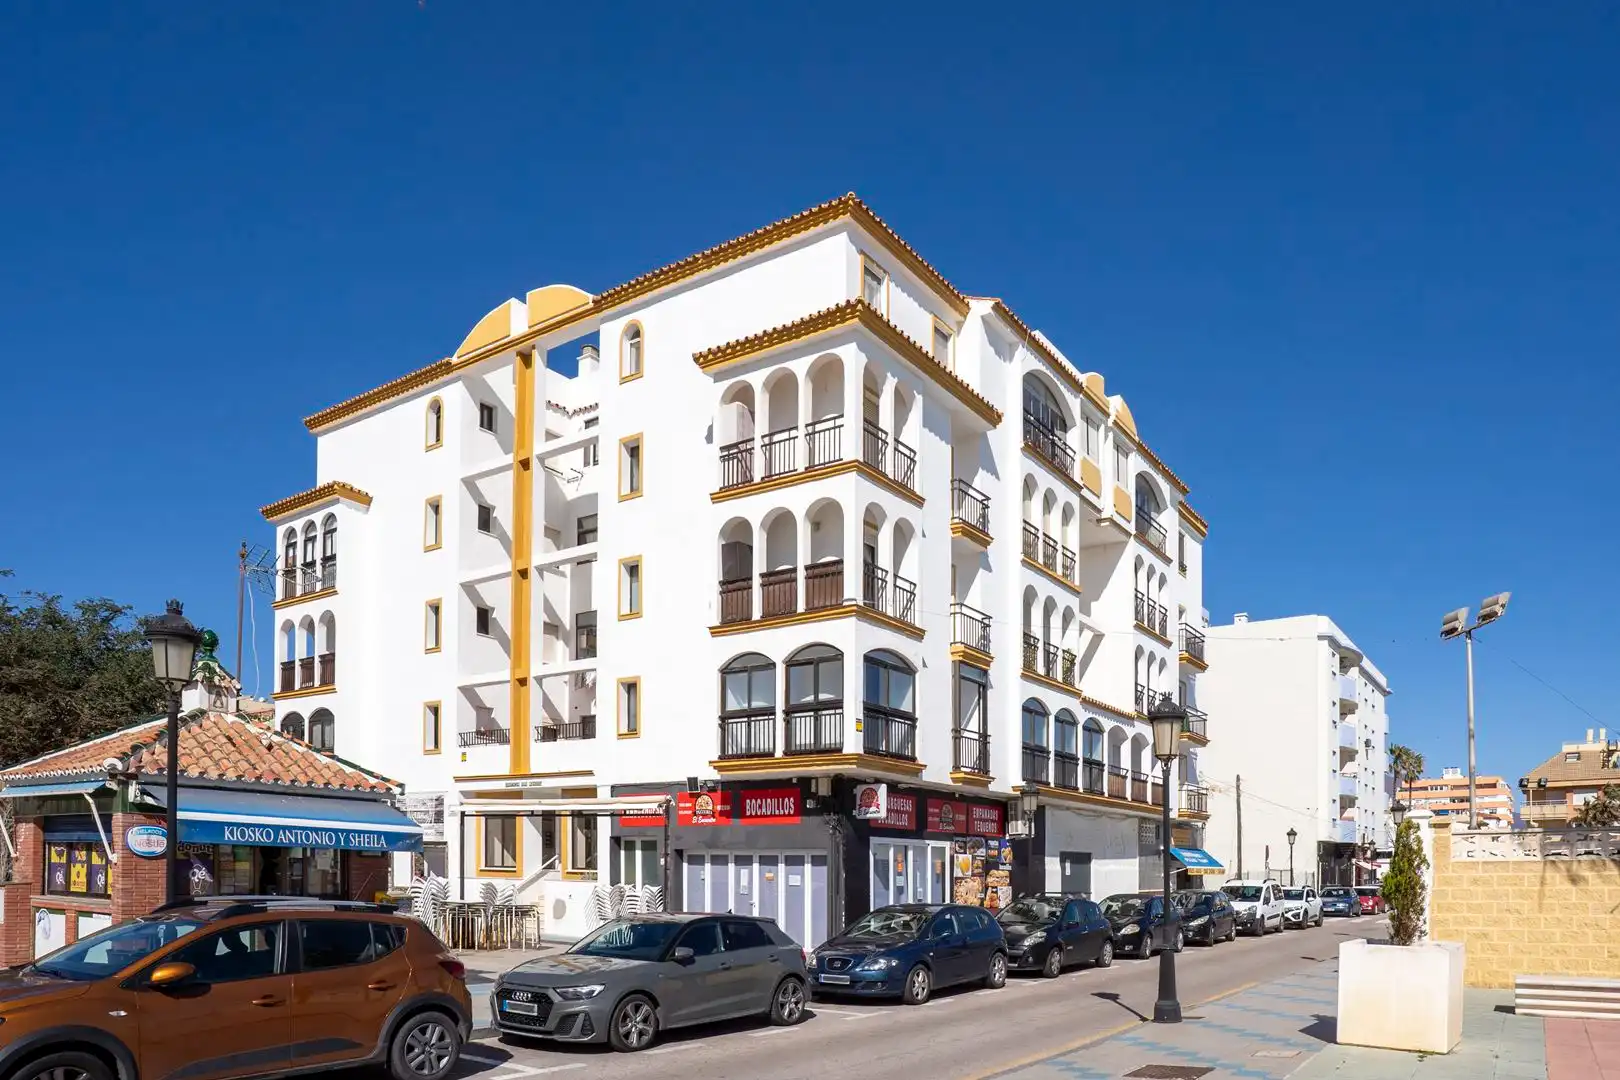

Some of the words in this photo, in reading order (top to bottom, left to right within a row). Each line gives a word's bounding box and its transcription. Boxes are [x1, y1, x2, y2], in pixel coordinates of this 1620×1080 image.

[745, 797, 795, 816] BOCADILLOS
[887, 796, 912, 812] URGUESAS
[878, 811, 909, 826] ADILLOS
[224, 826, 274, 843] KIOSKO
[277, 829, 336, 846] ANTONIO
[338, 832, 347, 846] Y
[350, 832, 387, 848] SHEILA
